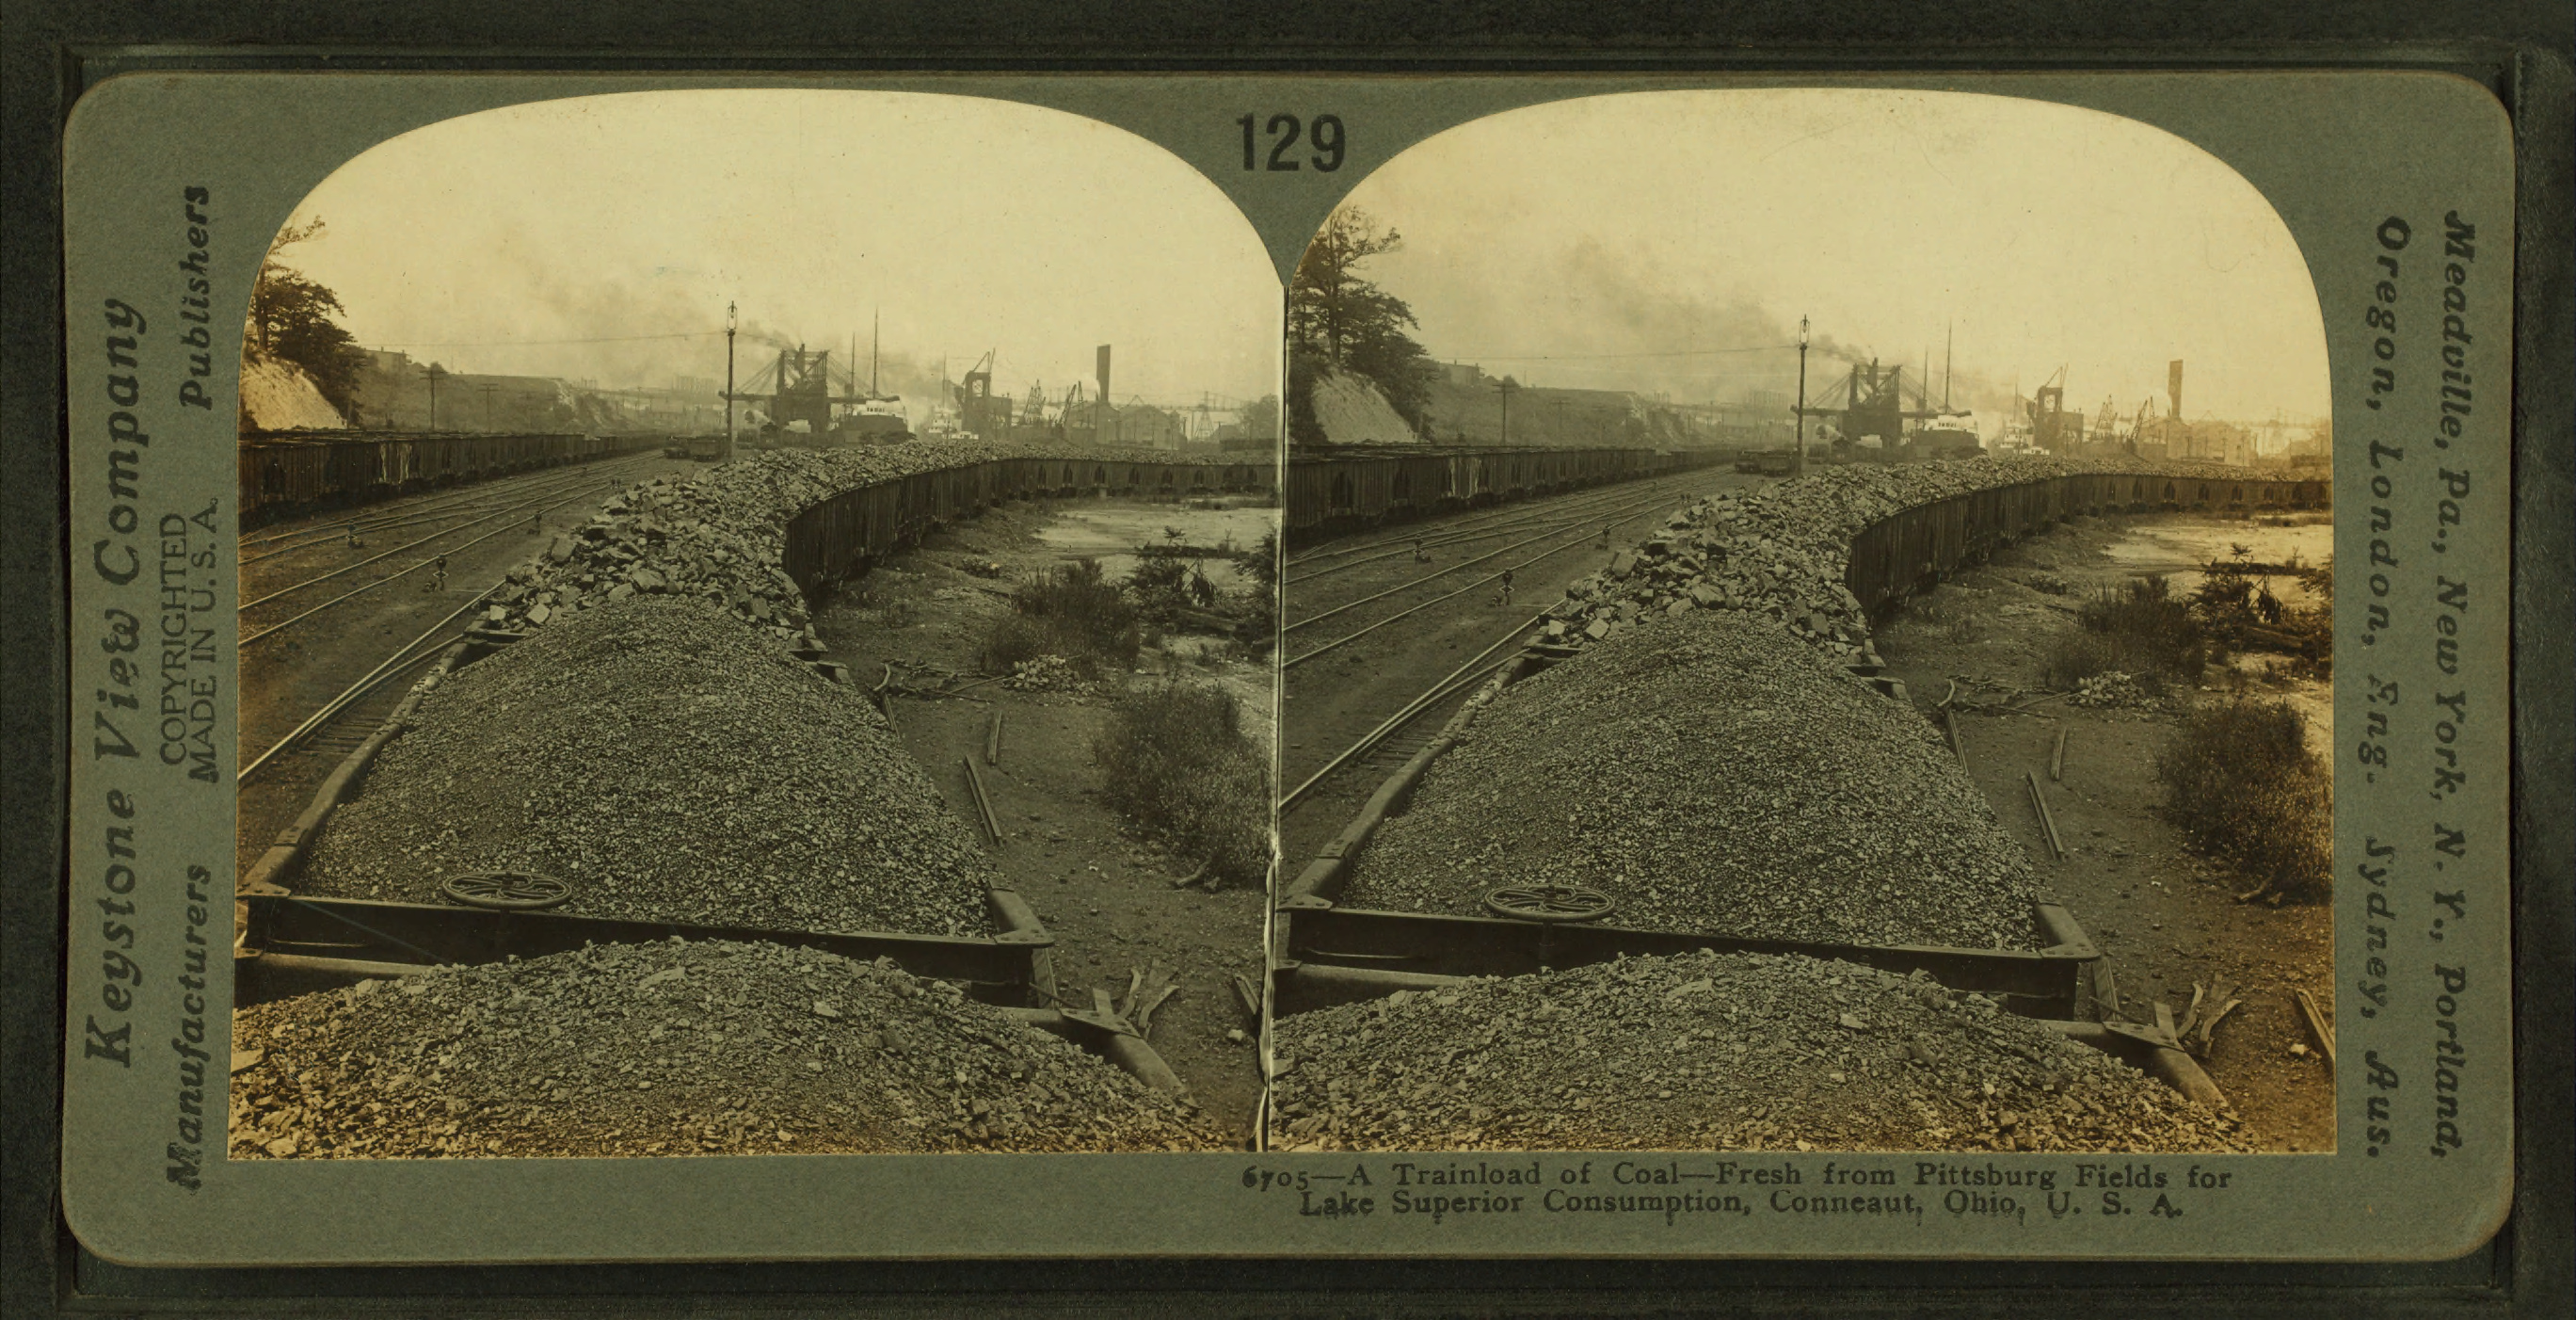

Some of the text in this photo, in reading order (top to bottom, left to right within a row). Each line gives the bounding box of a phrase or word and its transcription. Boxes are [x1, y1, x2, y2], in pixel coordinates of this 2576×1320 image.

[1236, 112, 1346, 173] 129
[178, 185, 213, 410] Publishers
[84, 298, 150, 1069] Keystone View Company
[158, 512, 187, 766] COPYRIGHTED
[187, 497, 220, 784] MADE IN U. S. A.
[2357, 215, 2412, 1158] Oregon, London, Eng. Sydney, Aus.
[2428, 209, 2476, 1158] Meadville, Pa., New York, N. Y., Portland,
[166, 864, 212, 1192] Manufacturers
[1300, 1188, 2184, 1222] Lake Superior Consumption, Conneaut, Ohio, U. S. A.
[1391, 1161, 1542, 1186] Trainload
[1560, 1161, 1592, 1185] of
[1822, 1161, 1896, 1186] from
[1913, 1161, 2057, 1184] Pittsburg
[2074, 1163, 2168, 1189] Fields
[2187, 1164, 2232, 1190] for
